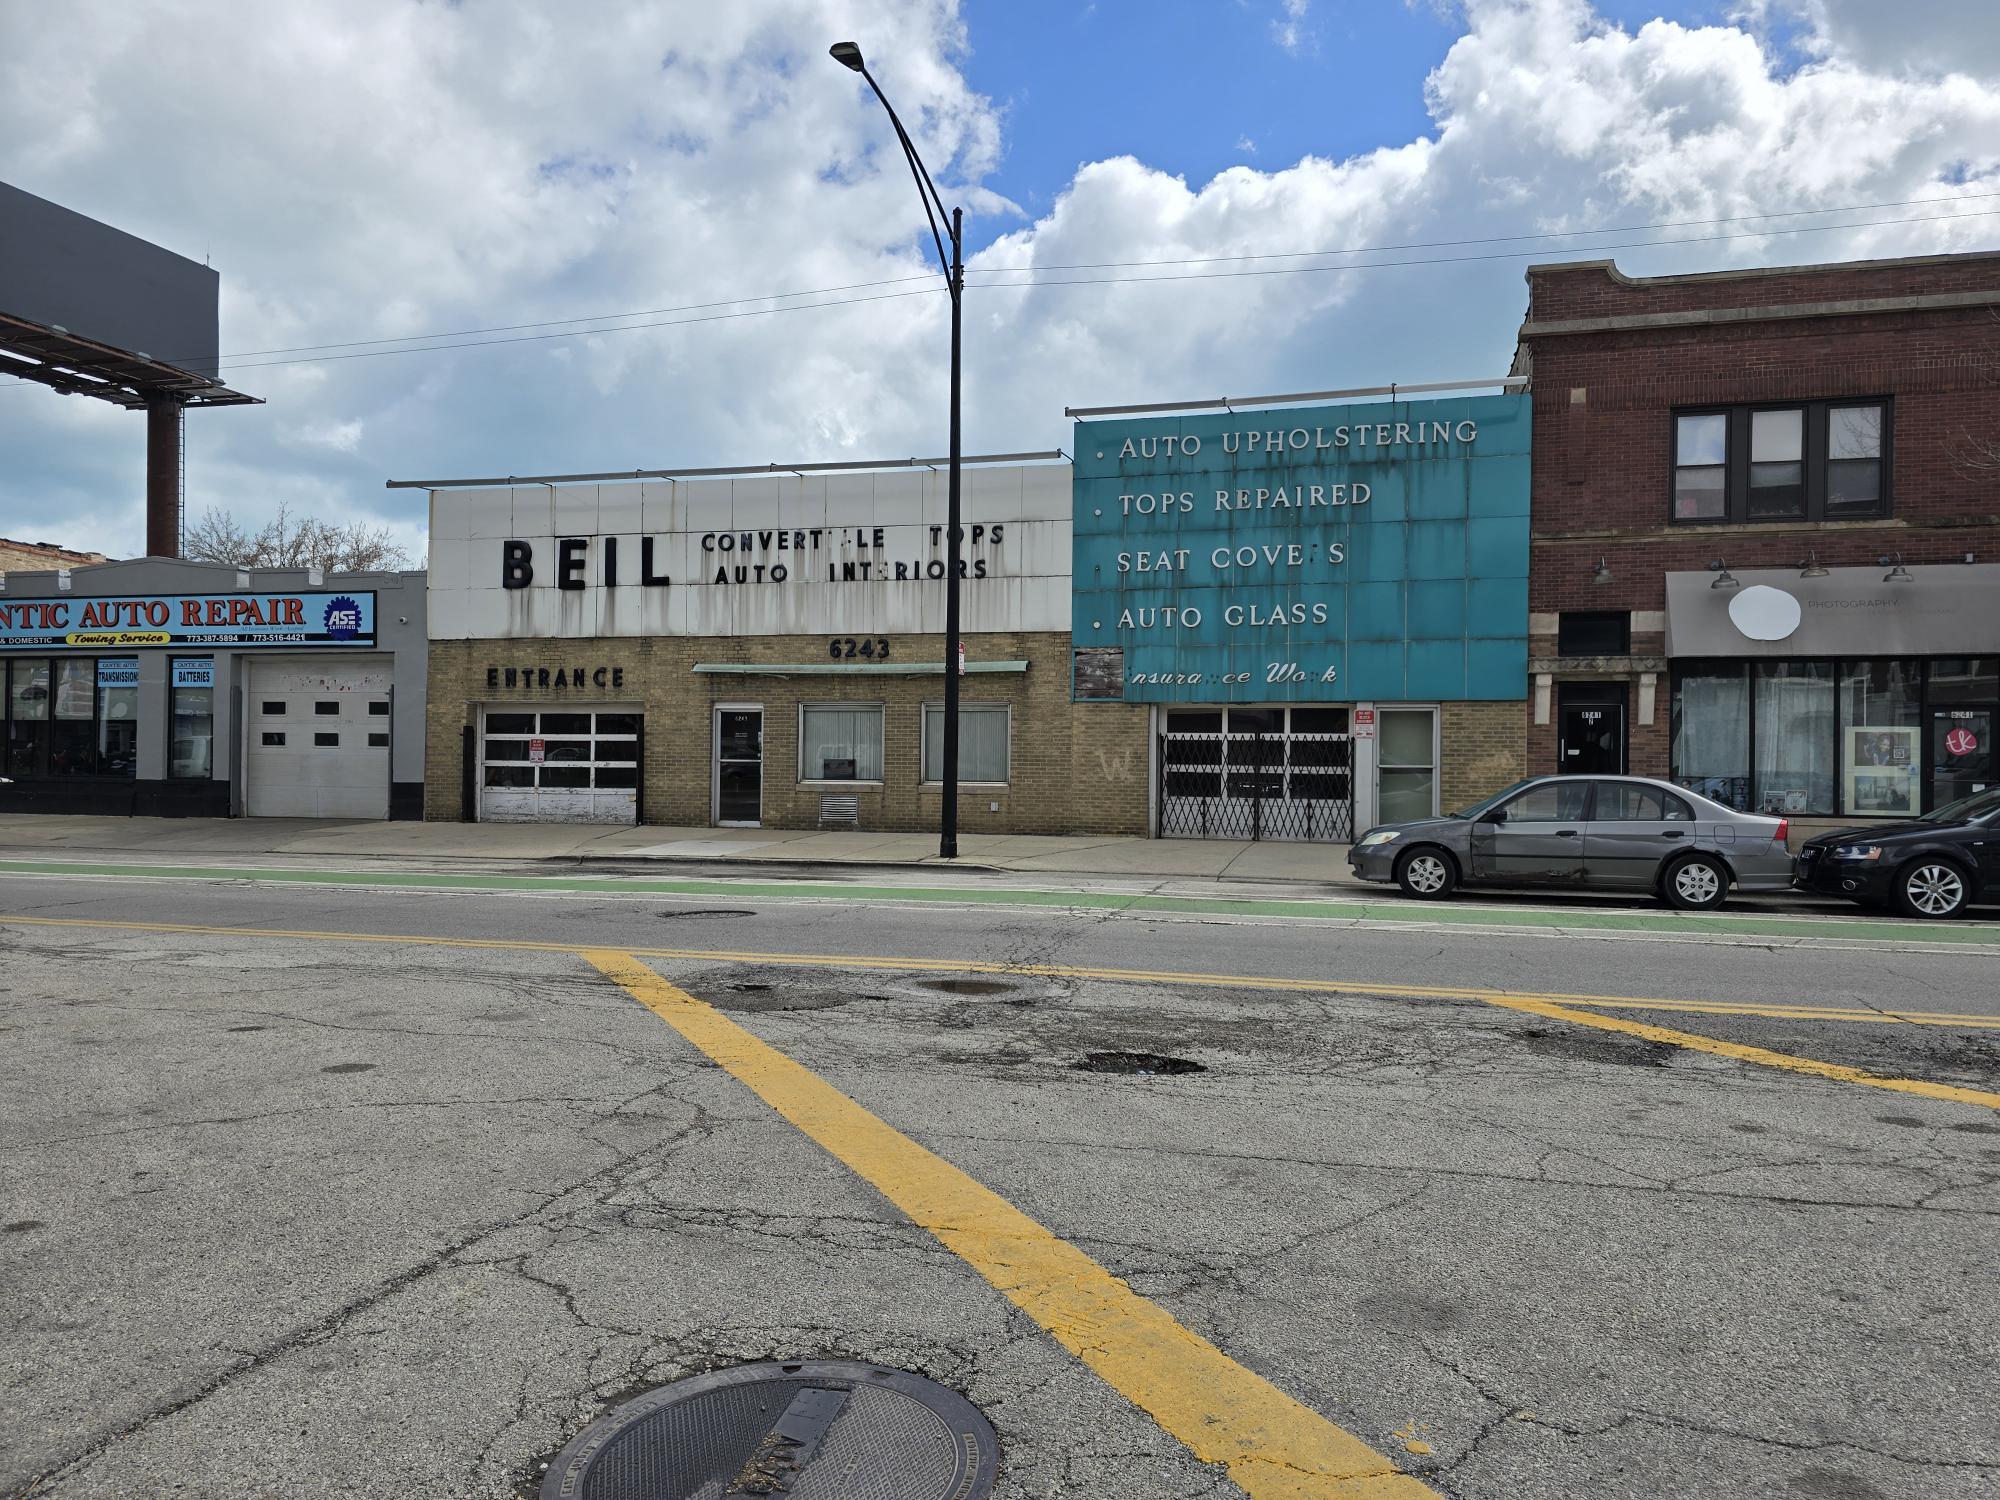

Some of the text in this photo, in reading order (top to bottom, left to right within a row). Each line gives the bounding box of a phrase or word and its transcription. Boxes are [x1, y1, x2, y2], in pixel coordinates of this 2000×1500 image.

[1118, 420, 1478, 459] AUTO UPHOLSTERING
[1118, 483, 1372, 516] TOPS REPAIRED
[701, 528, 884, 552] CONVERTLE
[502, 536, 670, 590] BEIL
[1117, 543, 1345, 573] SEAT COVES
[715, 559, 987, 584] AUTO INTRIORS
[0, 598, 307, 630] NTIC AUTO REPAIR
[1808, 599, 1899, 609] PHOTOGRAPHY
[328, 610, 356, 625] ASE
[1117, 603, 1329, 629] AUTO GLASS
[9, 637, 52, 645] DOMESTIC
[74, 633, 164, 645] Towing Service
[187, 634, 239, 642] 773-387-5894
[830, 639, 890, 658] 6243
[178, 671, 210, 682] BATTERIES
[487, 666, 623, 689] ENTRANCE
[1126, 662, 1337, 685] nsurace Wok
[954, 1475, 974, 1500] ORDAN
